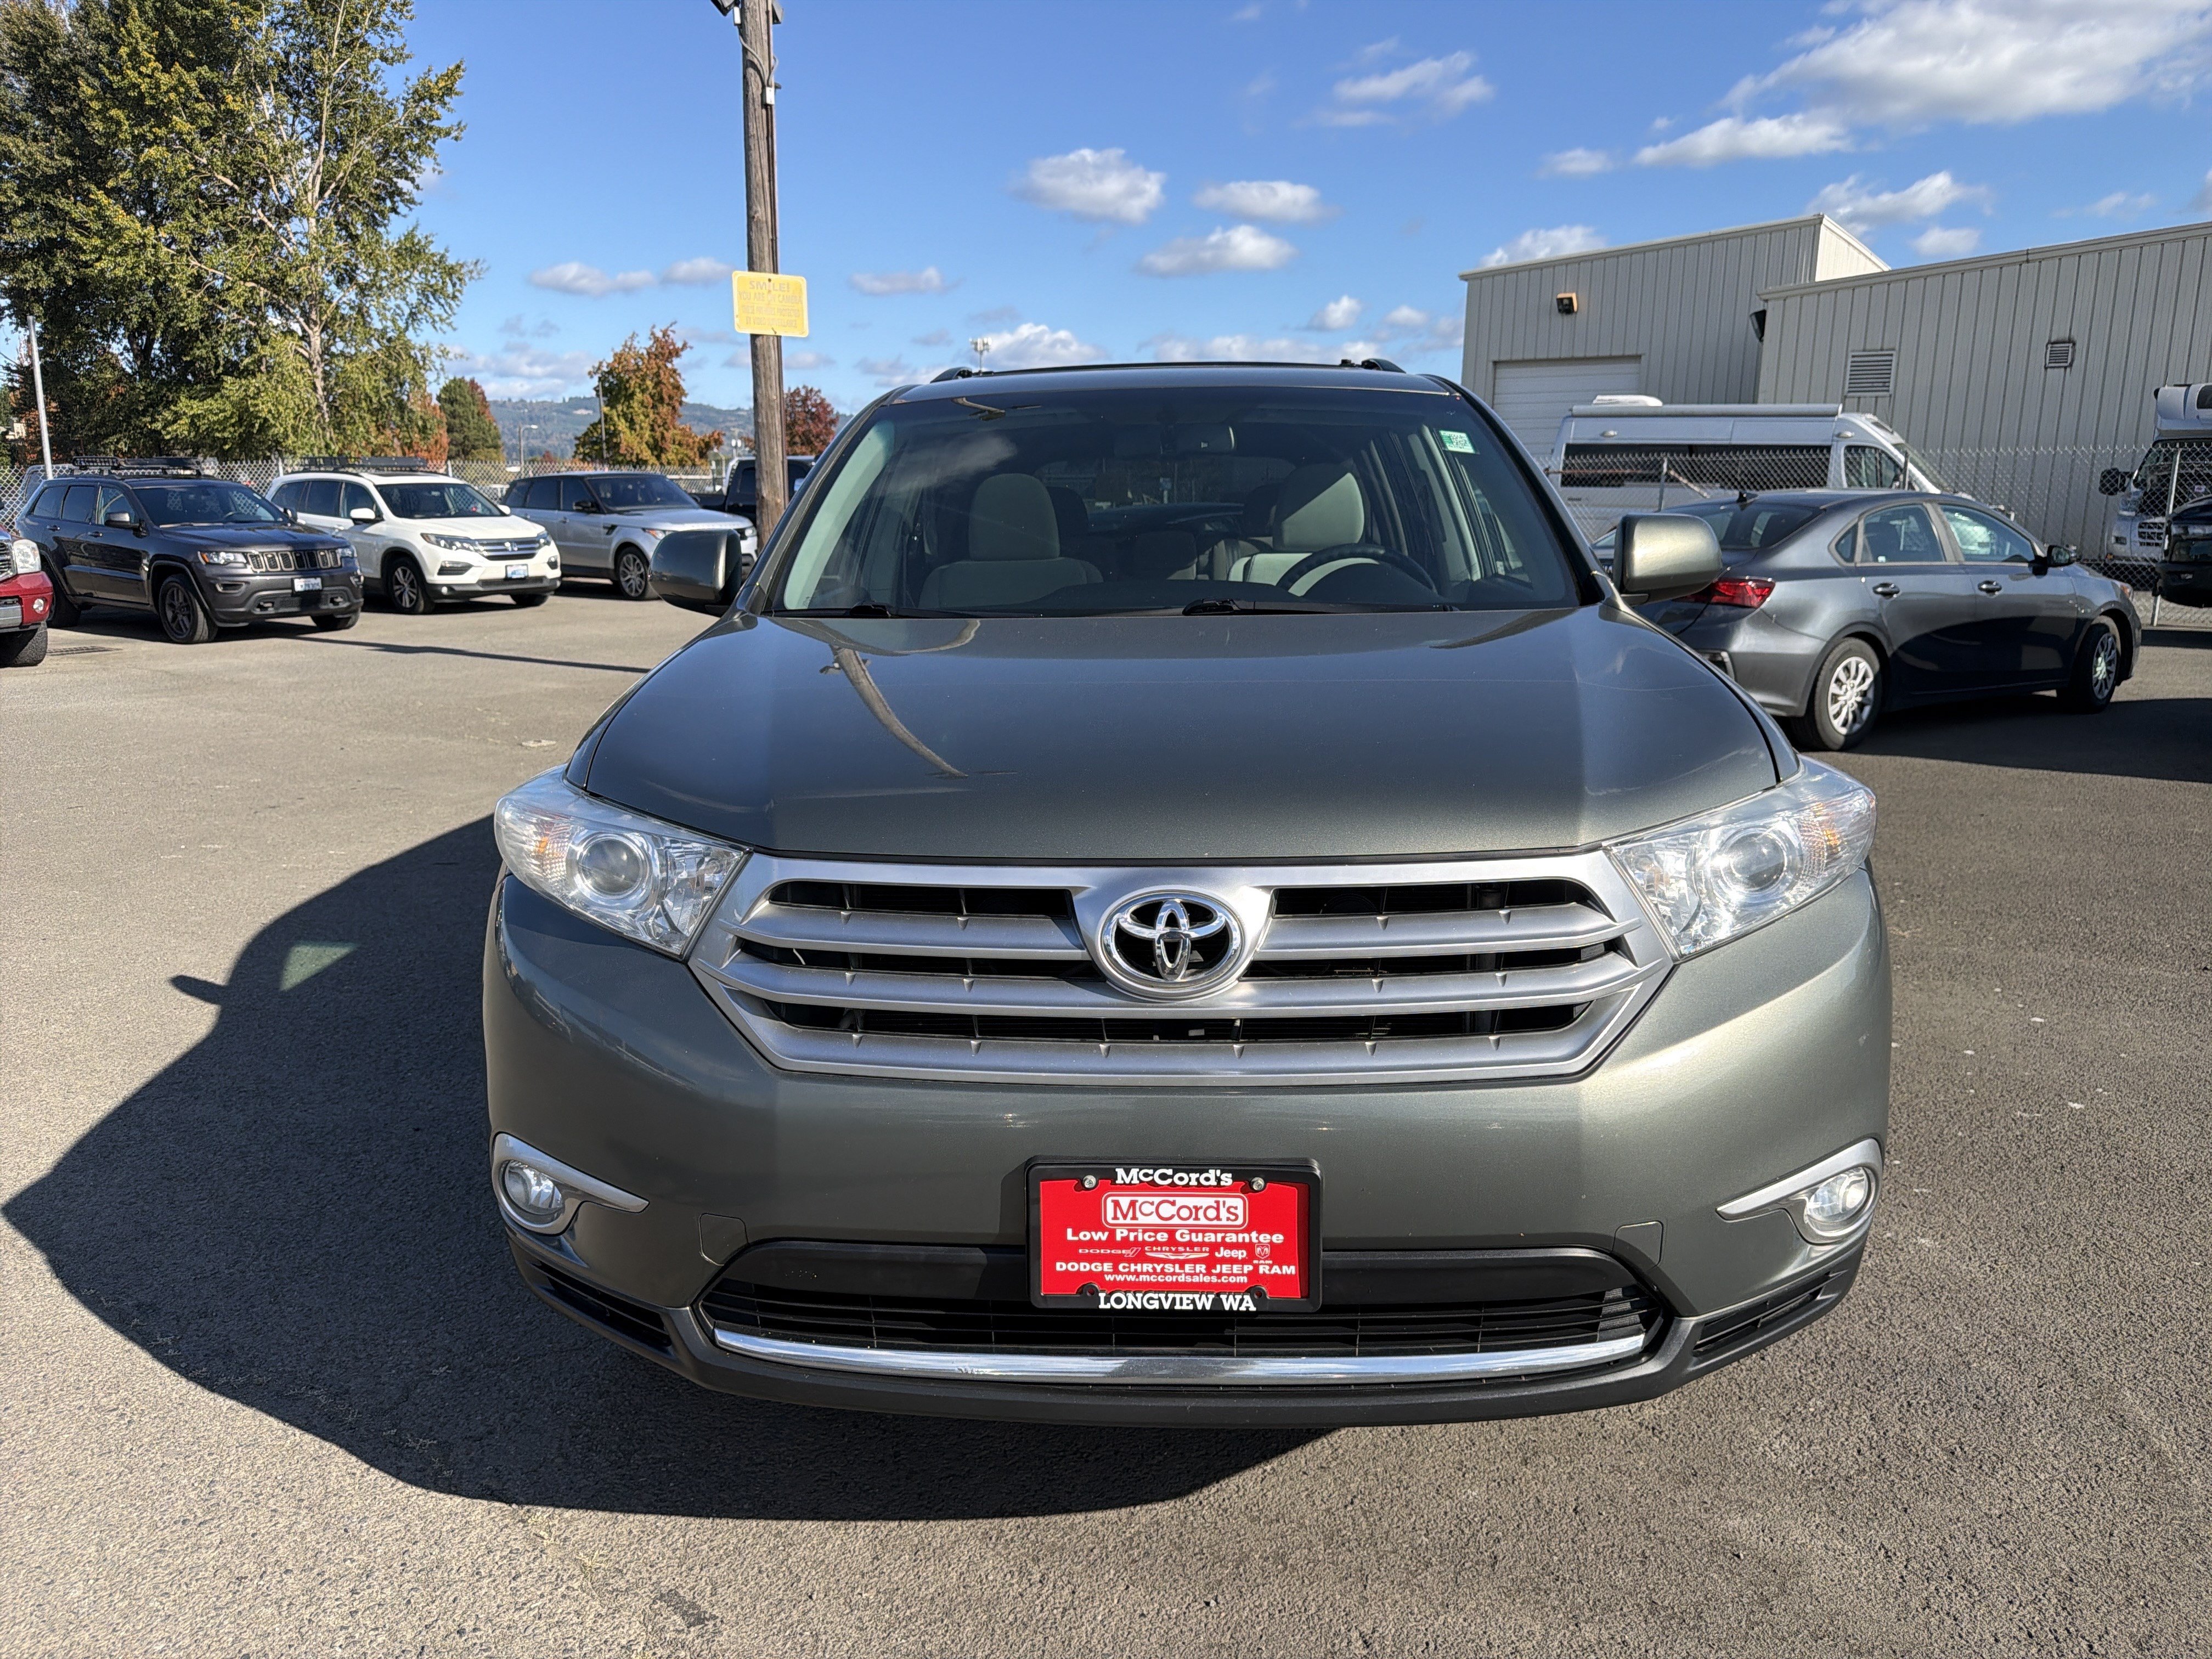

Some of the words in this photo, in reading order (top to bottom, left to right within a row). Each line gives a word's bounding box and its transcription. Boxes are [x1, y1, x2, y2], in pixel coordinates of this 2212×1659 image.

[749, 280, 789, 292] SMILE!
[739, 291, 751, 300] YOU
[1115, 1169, 1232, 1186] McCord's
[1111, 1199, 1239, 1222] McCord's
[1066, 1228, 1109, 1241] Low
[1115, 1228, 1169, 1242] Price
[1176, 1229, 1284, 1244] Guarantee
[1215, 1246, 1247, 1260] Jeep
[1056, 1262, 1113, 1272] DODGE
[1118, 1263, 1206, 1274] CHRYSLER
[1211, 1264, 1253, 1274] JEEP
[1259, 1265, 1296, 1275] RAM
[1104, 1273, 1248, 1283] www.mccordsales.com
[1099, 1292, 1215, 1310] LONGVIEW
[1220, 1294, 1256, 1311] WA
